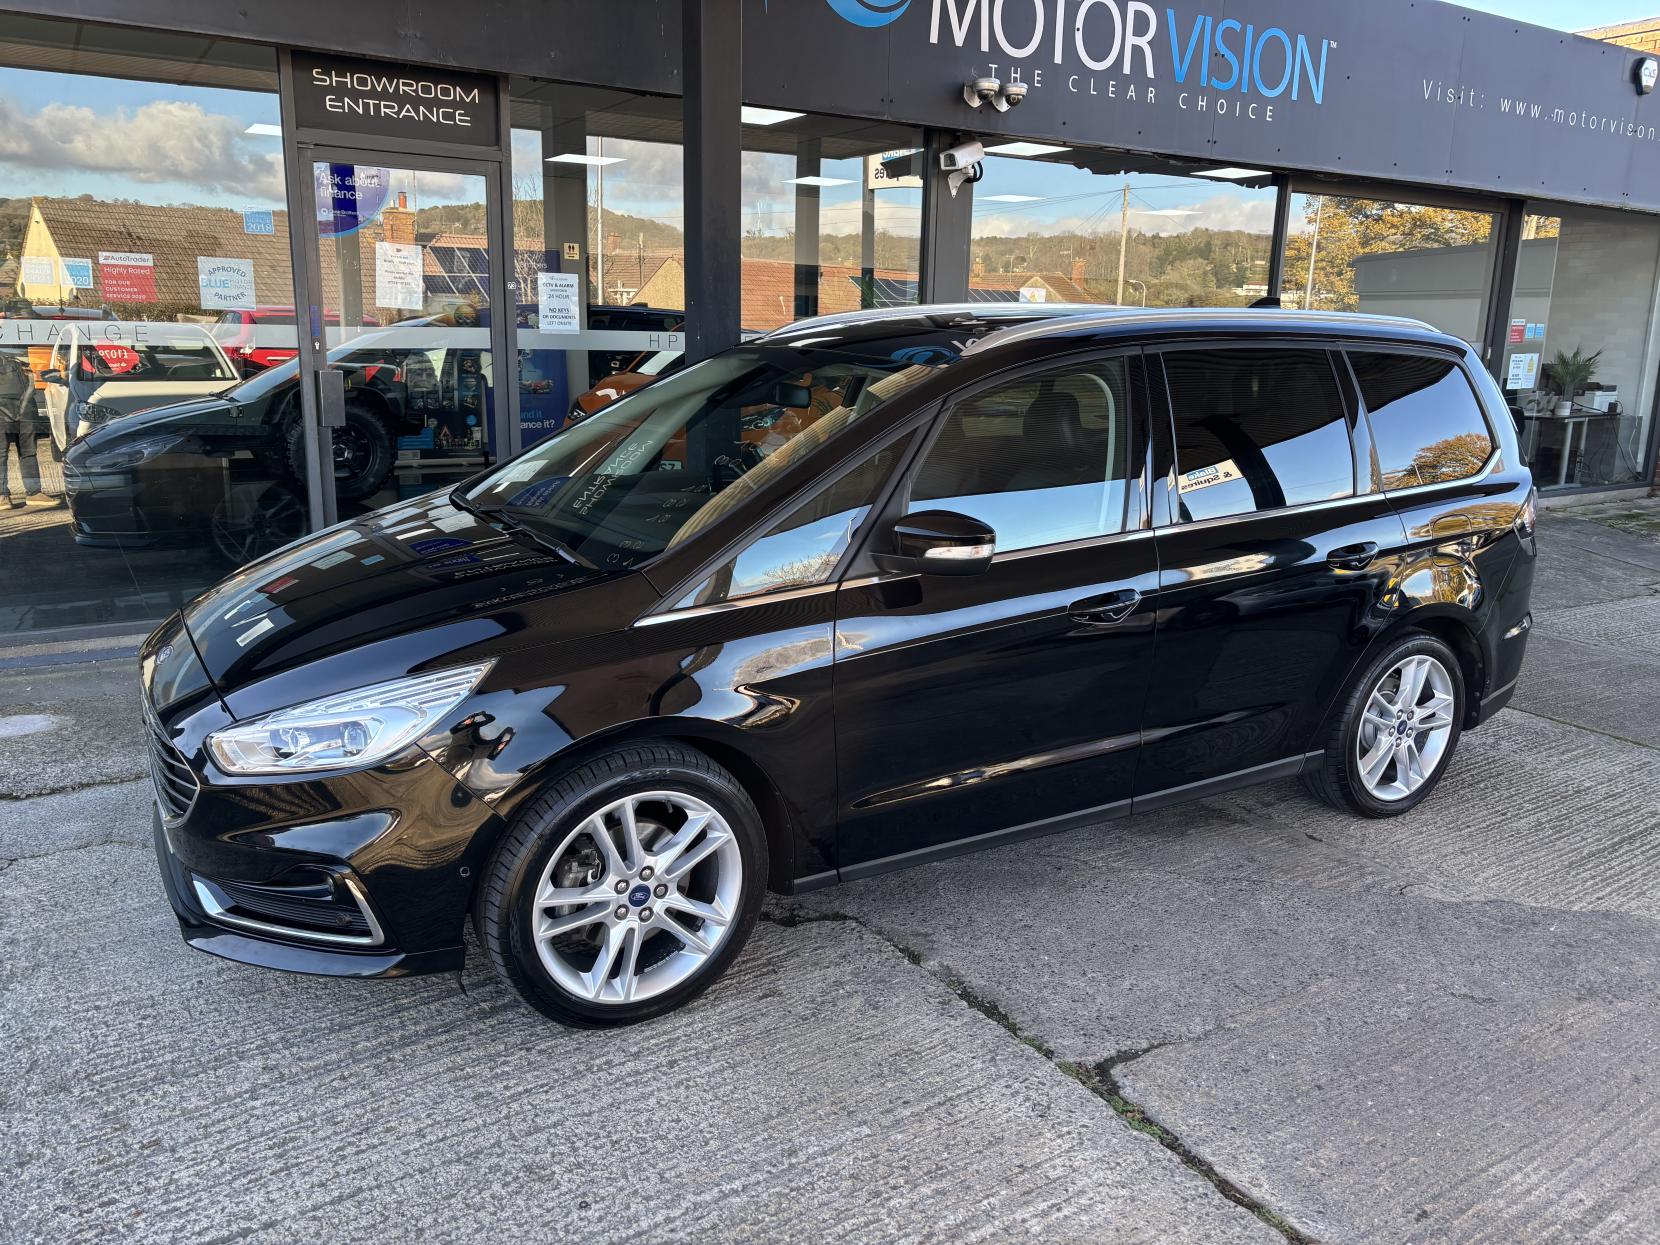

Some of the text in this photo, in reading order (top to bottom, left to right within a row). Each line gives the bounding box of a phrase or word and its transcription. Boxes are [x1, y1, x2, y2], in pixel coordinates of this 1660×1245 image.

[312, 68, 479, 103] SHOWROOM
[988, 63, 1275, 121] THE CLEAR CHOICE
[1423, 79, 1485, 108] Visit:
[325, 95, 471, 126] ENTRANCE
[319, 172, 342, 185] Ask
[320, 186, 363, 200] finance
[247, 223, 272, 233] 2018
[110, 255, 150, 263] AutoTrader
[104, 266, 150, 275] Highly Rated
[207, 265, 246, 278] APPROVED
[201, 277, 230, 289] BLUE
[214, 291, 247, 301] PARTNER
[0, 323, 149, 342] HANGE
[520, 419, 556, 429] ance it?
